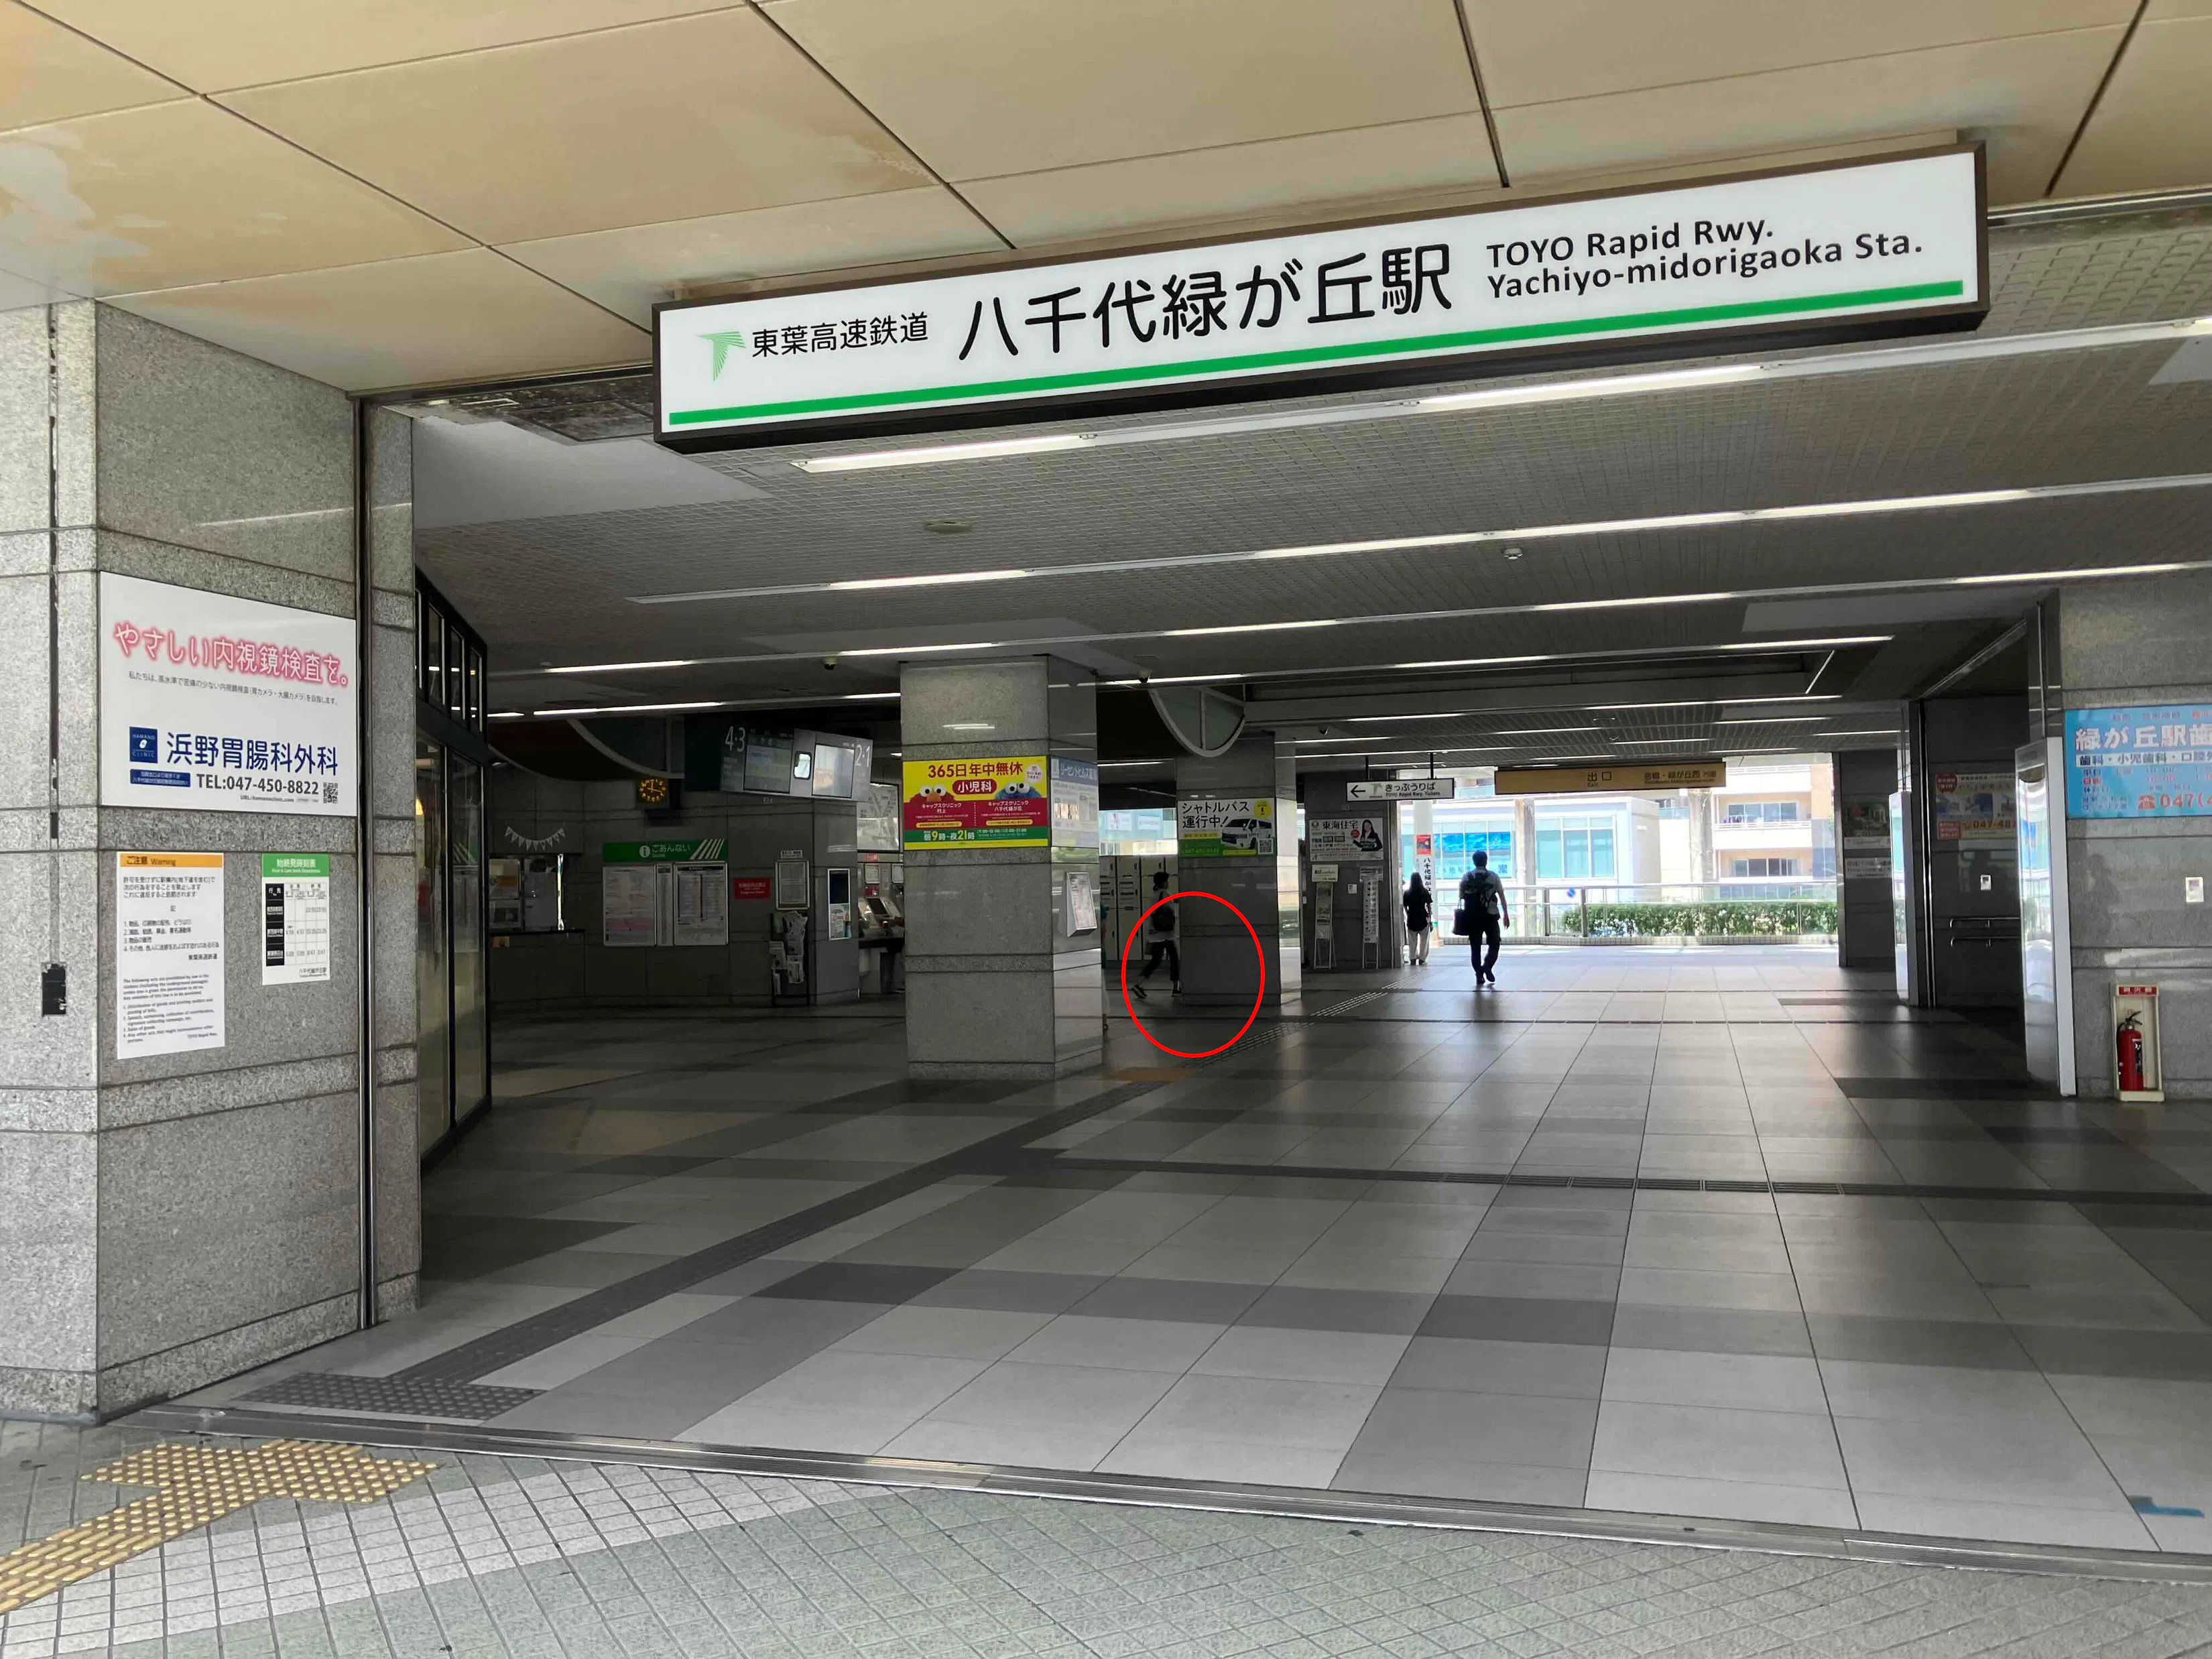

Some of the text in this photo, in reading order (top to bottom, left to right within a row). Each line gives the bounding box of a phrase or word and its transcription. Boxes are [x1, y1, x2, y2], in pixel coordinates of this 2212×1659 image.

[1486, 219, 1774, 268] TOYO Rapid Rwy.
[1487, 232, 1922, 299] Yachiyo-midorigaoka Sta.
[959, 243, 1452, 361] 八千代緑が丘駅
[752, 312, 928, 358] 東葉高速鉄道
[115, 623, 348, 686] やさしい内視鏡検査を。
[168, 732, 338, 776] 浜野胃腸科外科
[928, 761, 1023, 778] 365日年中無休
[1587, 772, 1611, 782] 出口
[196, 774, 318, 795] TEL:047-450-8822
[957, 781, 991, 792] 小児科
[1386, 782, 1436, 792] きっぷうりば
[1182, 801, 1249, 814] シャトルバス
[1182, 814, 1229, 828] 運行中!
[1323, 820, 1359, 829] 東海住宅
[127, 856, 148, 865] ご注意
